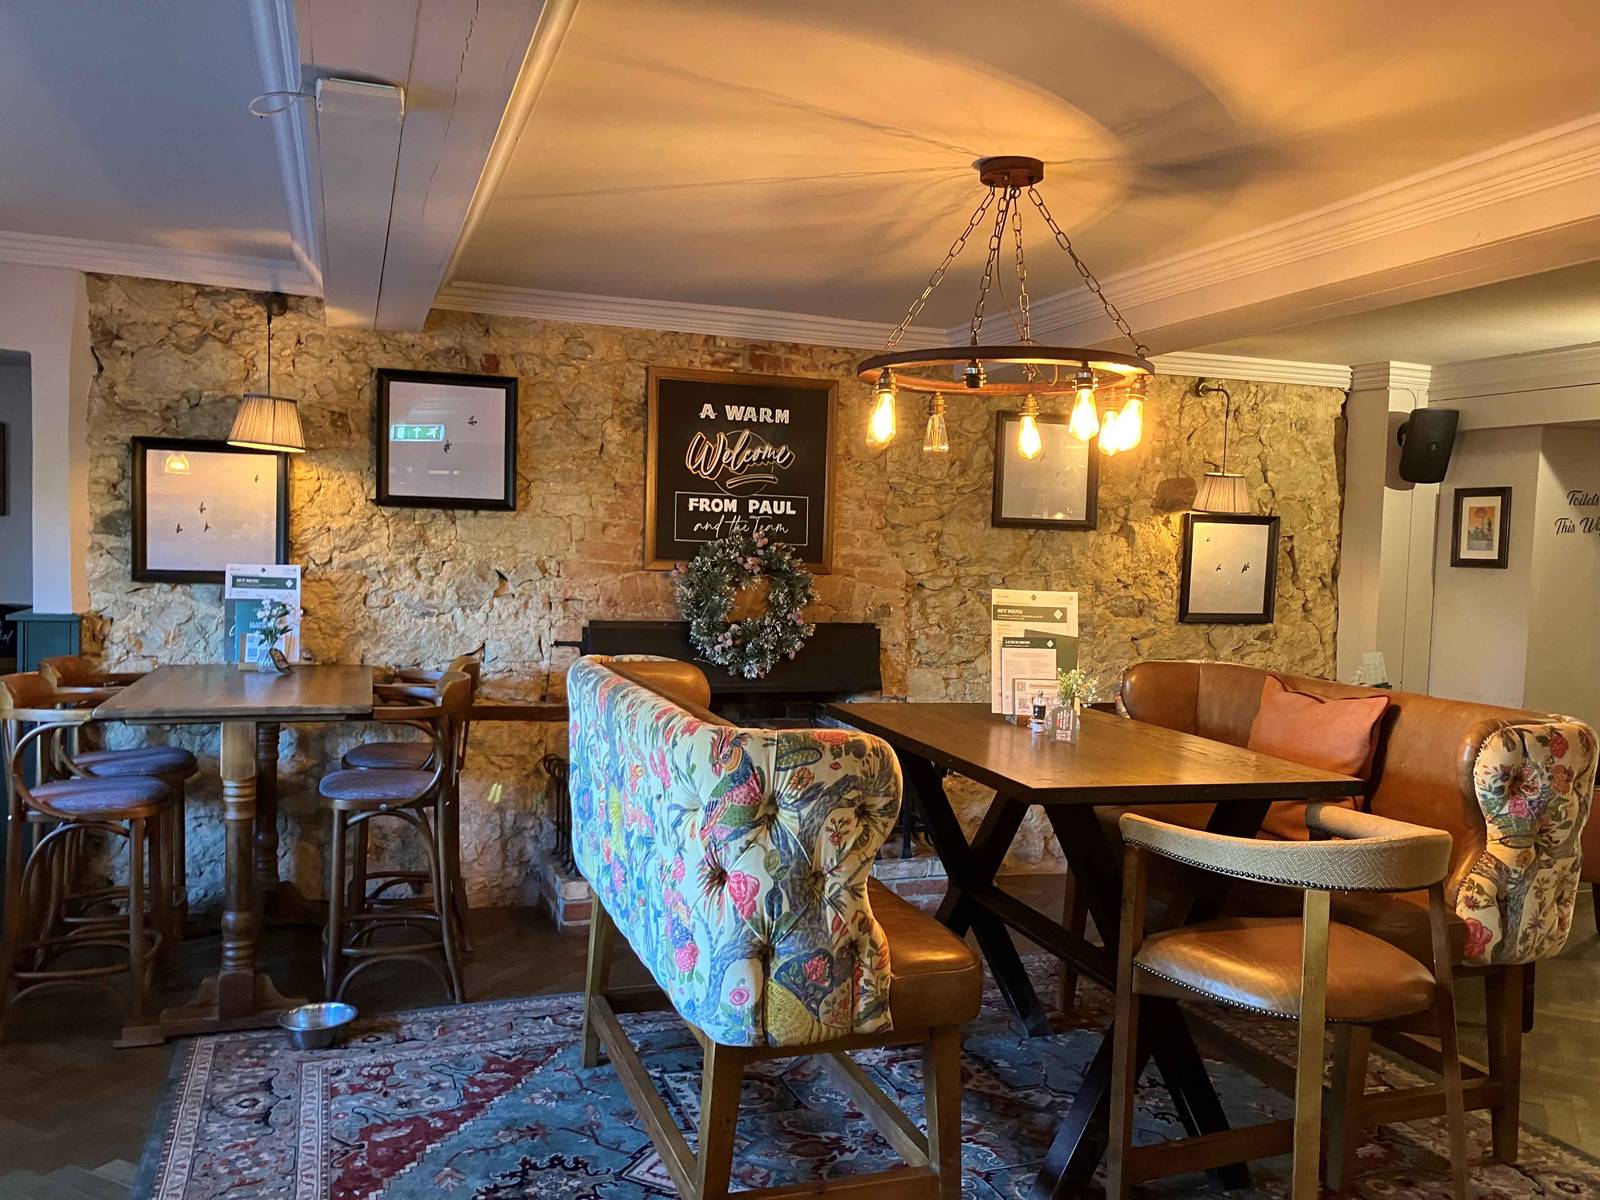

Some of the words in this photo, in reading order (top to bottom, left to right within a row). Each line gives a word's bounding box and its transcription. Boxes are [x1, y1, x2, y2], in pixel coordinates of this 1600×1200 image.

[699, 403, 718, 419] A
[725, 405, 790, 424] WARM
[686, 428, 795, 480] Welcome
[688, 498, 738, 513] FROM
[748, 499, 797, 515] PAUL
[1566, 490, 1600, 506] Toilets
[693, 514, 725, 538] and
[725, 515, 750, 534] the
[748, 515, 789, 534] Team
[1554, 517, 1576, 536] This
